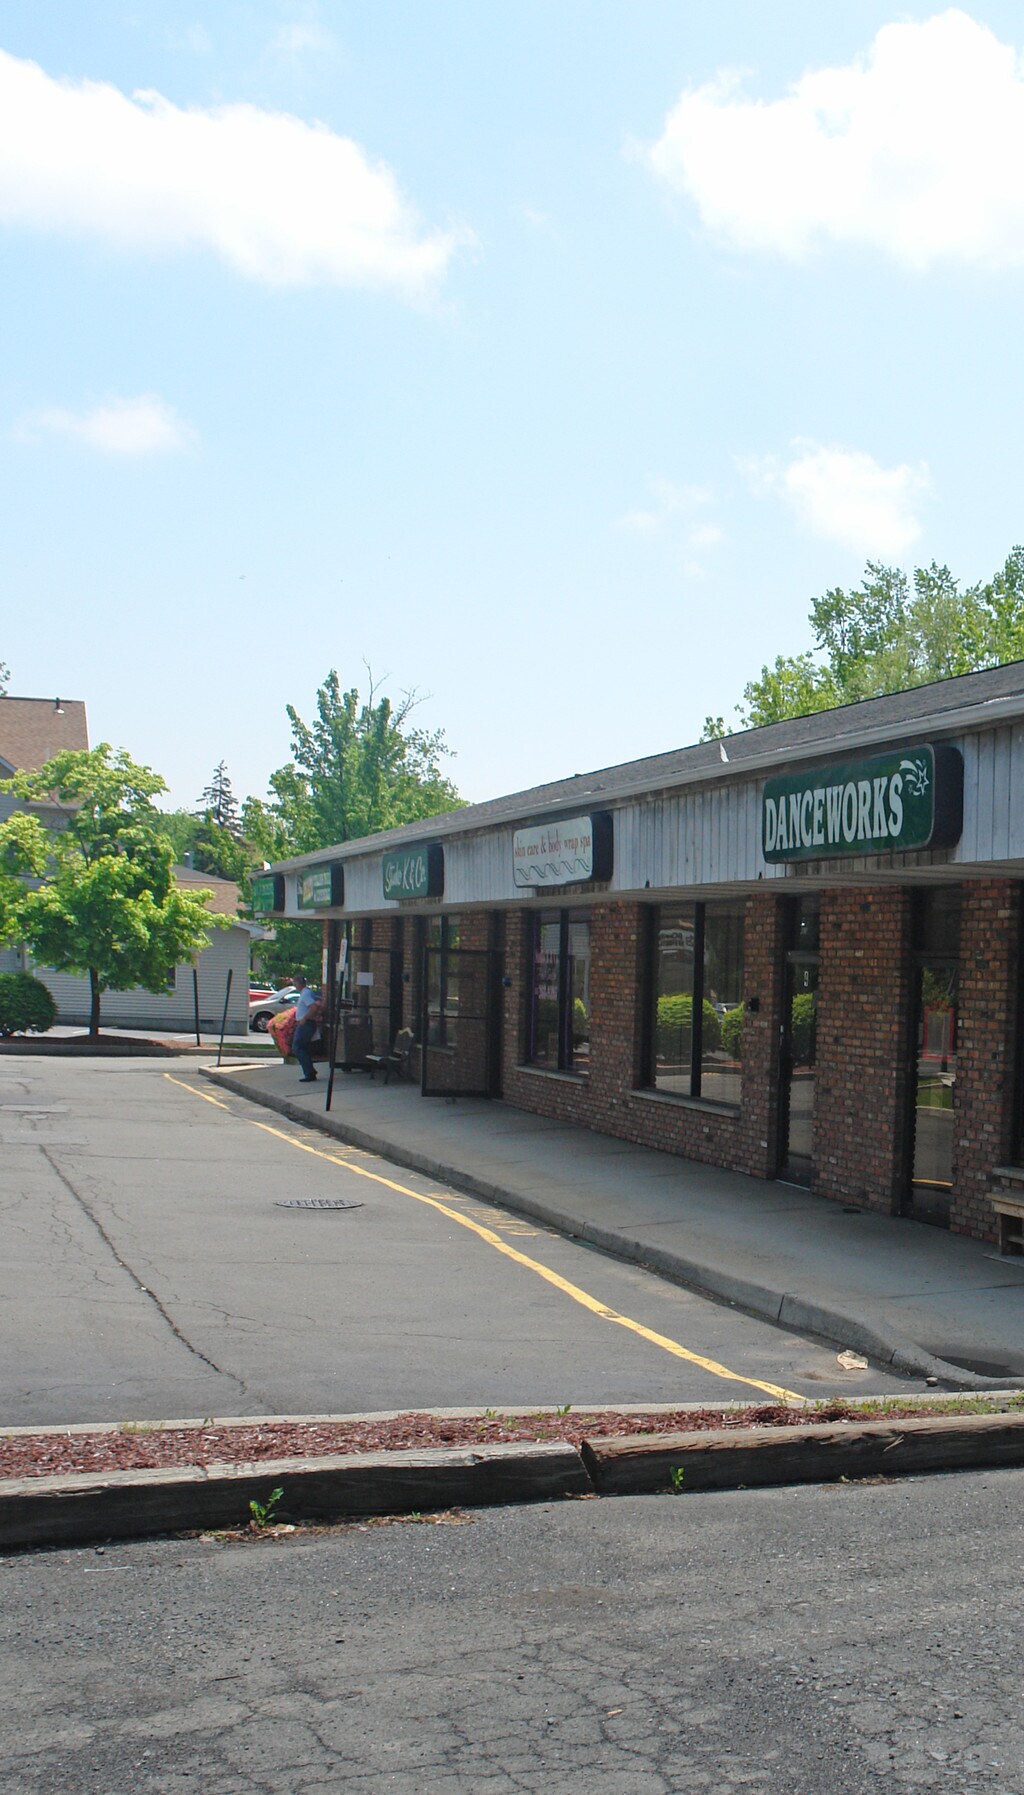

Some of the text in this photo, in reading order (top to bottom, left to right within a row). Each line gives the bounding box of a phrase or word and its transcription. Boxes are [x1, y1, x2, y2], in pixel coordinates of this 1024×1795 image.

[765, 773, 904, 852] DANCEWORKS
[515, 829, 591, 857] skin care & body wrap spa
